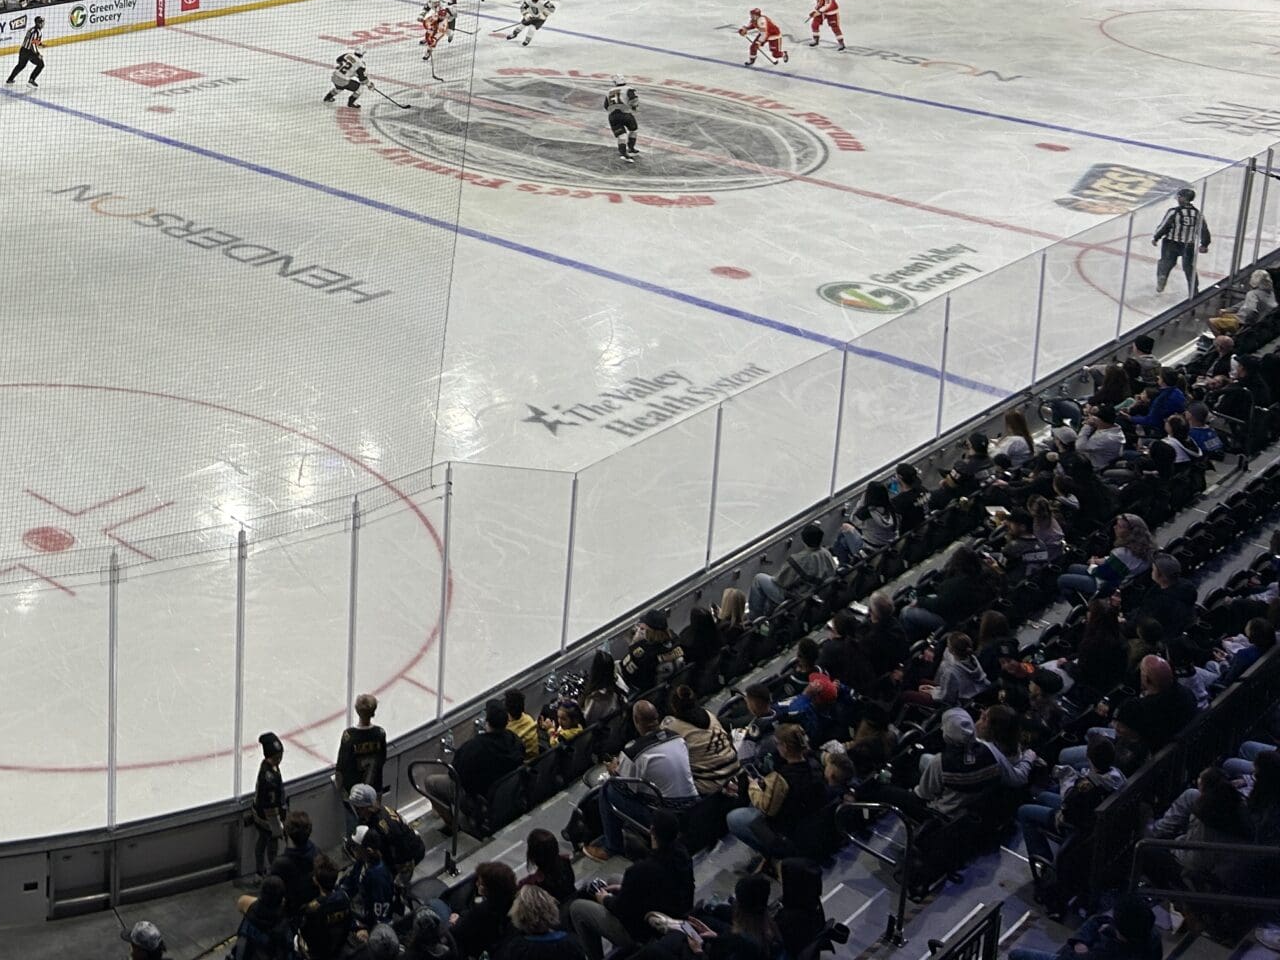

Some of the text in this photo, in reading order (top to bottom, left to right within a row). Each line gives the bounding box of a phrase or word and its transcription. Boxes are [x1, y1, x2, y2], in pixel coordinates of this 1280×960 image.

[89, 12, 122, 24] Grocery
[54, 184, 393, 304] HENDERSON
[904, 260, 982, 295] Grocery
[563, 368, 693, 429] The Valley
[601, 361, 771, 439] Health System
